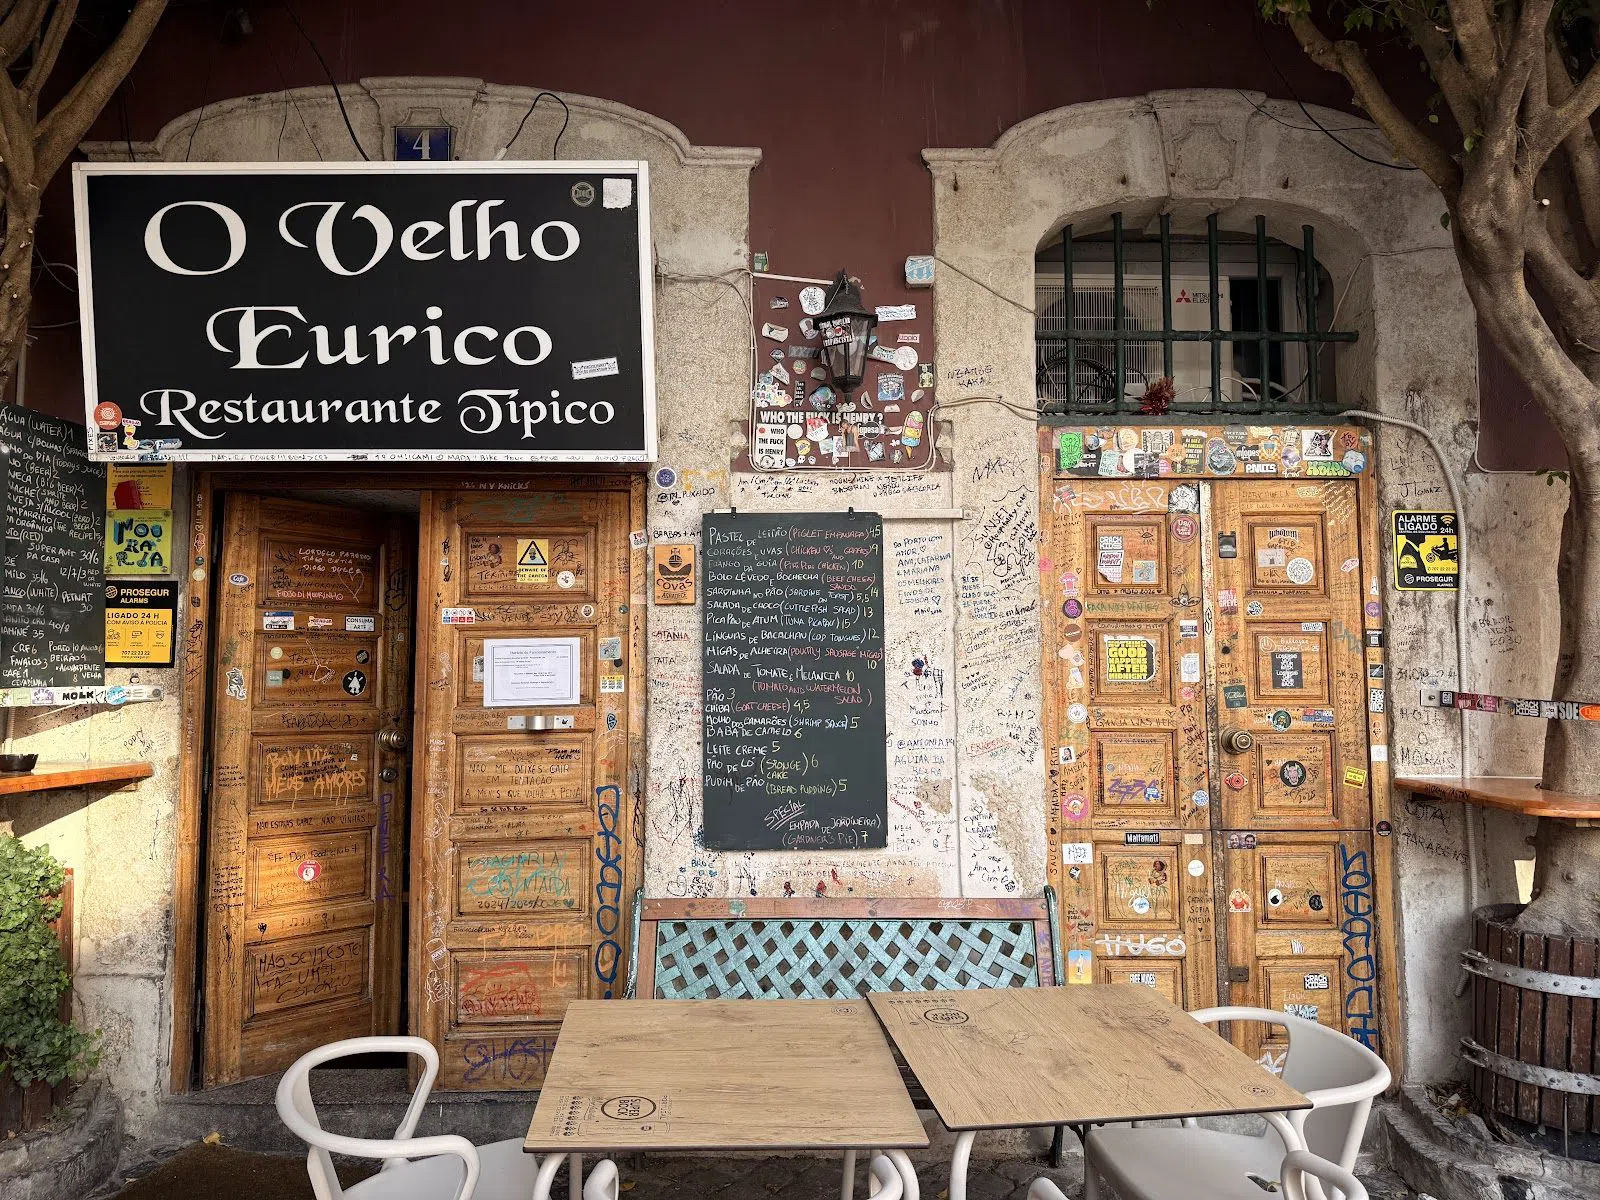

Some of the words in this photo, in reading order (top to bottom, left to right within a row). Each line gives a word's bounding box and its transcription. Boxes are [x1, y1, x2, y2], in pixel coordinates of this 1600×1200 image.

[413, 129, 431, 159] 4
[145, 201, 246, 275] O
[279, 200, 581, 276] Velho
[206, 305, 553, 369] Eurico
[140, 389, 442, 439] Restaurante
[458, 389, 615, 438] Típico
[760, 411, 785, 423] WHO
[786, 411, 804, 423] THE
[765, 448, 784, 456] HENRY
[1398, 523, 1438, 531] LIGADO
[709, 526, 744, 546] PASTEL
[761, 547, 782, 555] UVAS
[872, 543, 879, 556] 9
[852, 559, 864, 570] 10
[709, 571, 732, 582] BOLO
[776, 571, 818, 581] BOCHECHA
[120, 589, 169, 597] PROSEGUR
[707, 587, 751, 597] SARDINHA
[766, 587, 783, 596] PÃO
[707, 601, 740, 609] SALADA
[863, 606, 873, 618] 13
[752, 615, 779, 625] ATUM
[868, 628, 880, 640] 12
[1108, 640, 1147, 648] NOTHING
[707, 646, 738, 656] MIGAS
[750, 647, 788, 656] ALHEIRA
[1108, 647, 1147, 658] GOOD
[867, 660, 877, 669] 10
[1109, 664, 1147, 673] AFTER
[706, 661, 740, 675] SALADA
[750, 663, 788, 678] TOMATE
[796, 664, 840, 681] MELANCIA
[707, 688, 725, 701] PÃO
[727, 688, 736, 699] 3
[705, 703, 730, 713] CHIBA
[706, 715, 731, 725] MOLHO
[744, 716, 787, 726] CAMARÕES
[851, 717, 860, 728] 5
[706, 725, 739, 738] BABA
[755, 727, 792, 737] CAMELO
[794, 729, 802, 738] 6
[707, 742, 731, 755] LEITE
[736, 745, 767, 755] CREME
[772, 741, 780, 752] 5
[727, 764, 738, 774] DE
[741, 757, 755, 767] LÓ
[811, 754, 819, 767] 6
[767, 771, 788, 779] CAKE
[705, 775, 733, 787] PUDIM
[735, 784, 745, 792] DE
[839, 779, 847, 792] 5
[764, 800, 806, 827] SPECIAL
[789, 820, 820, 831] EMPADA
[861, 831, 868, 843] 7
[1127, 833, 1159, 843] Malfamati
[1129, 974, 1141, 984] FREE
[618, 1099, 629, 1117] BOCK
[629, 1098, 641, 1117] SUPER
